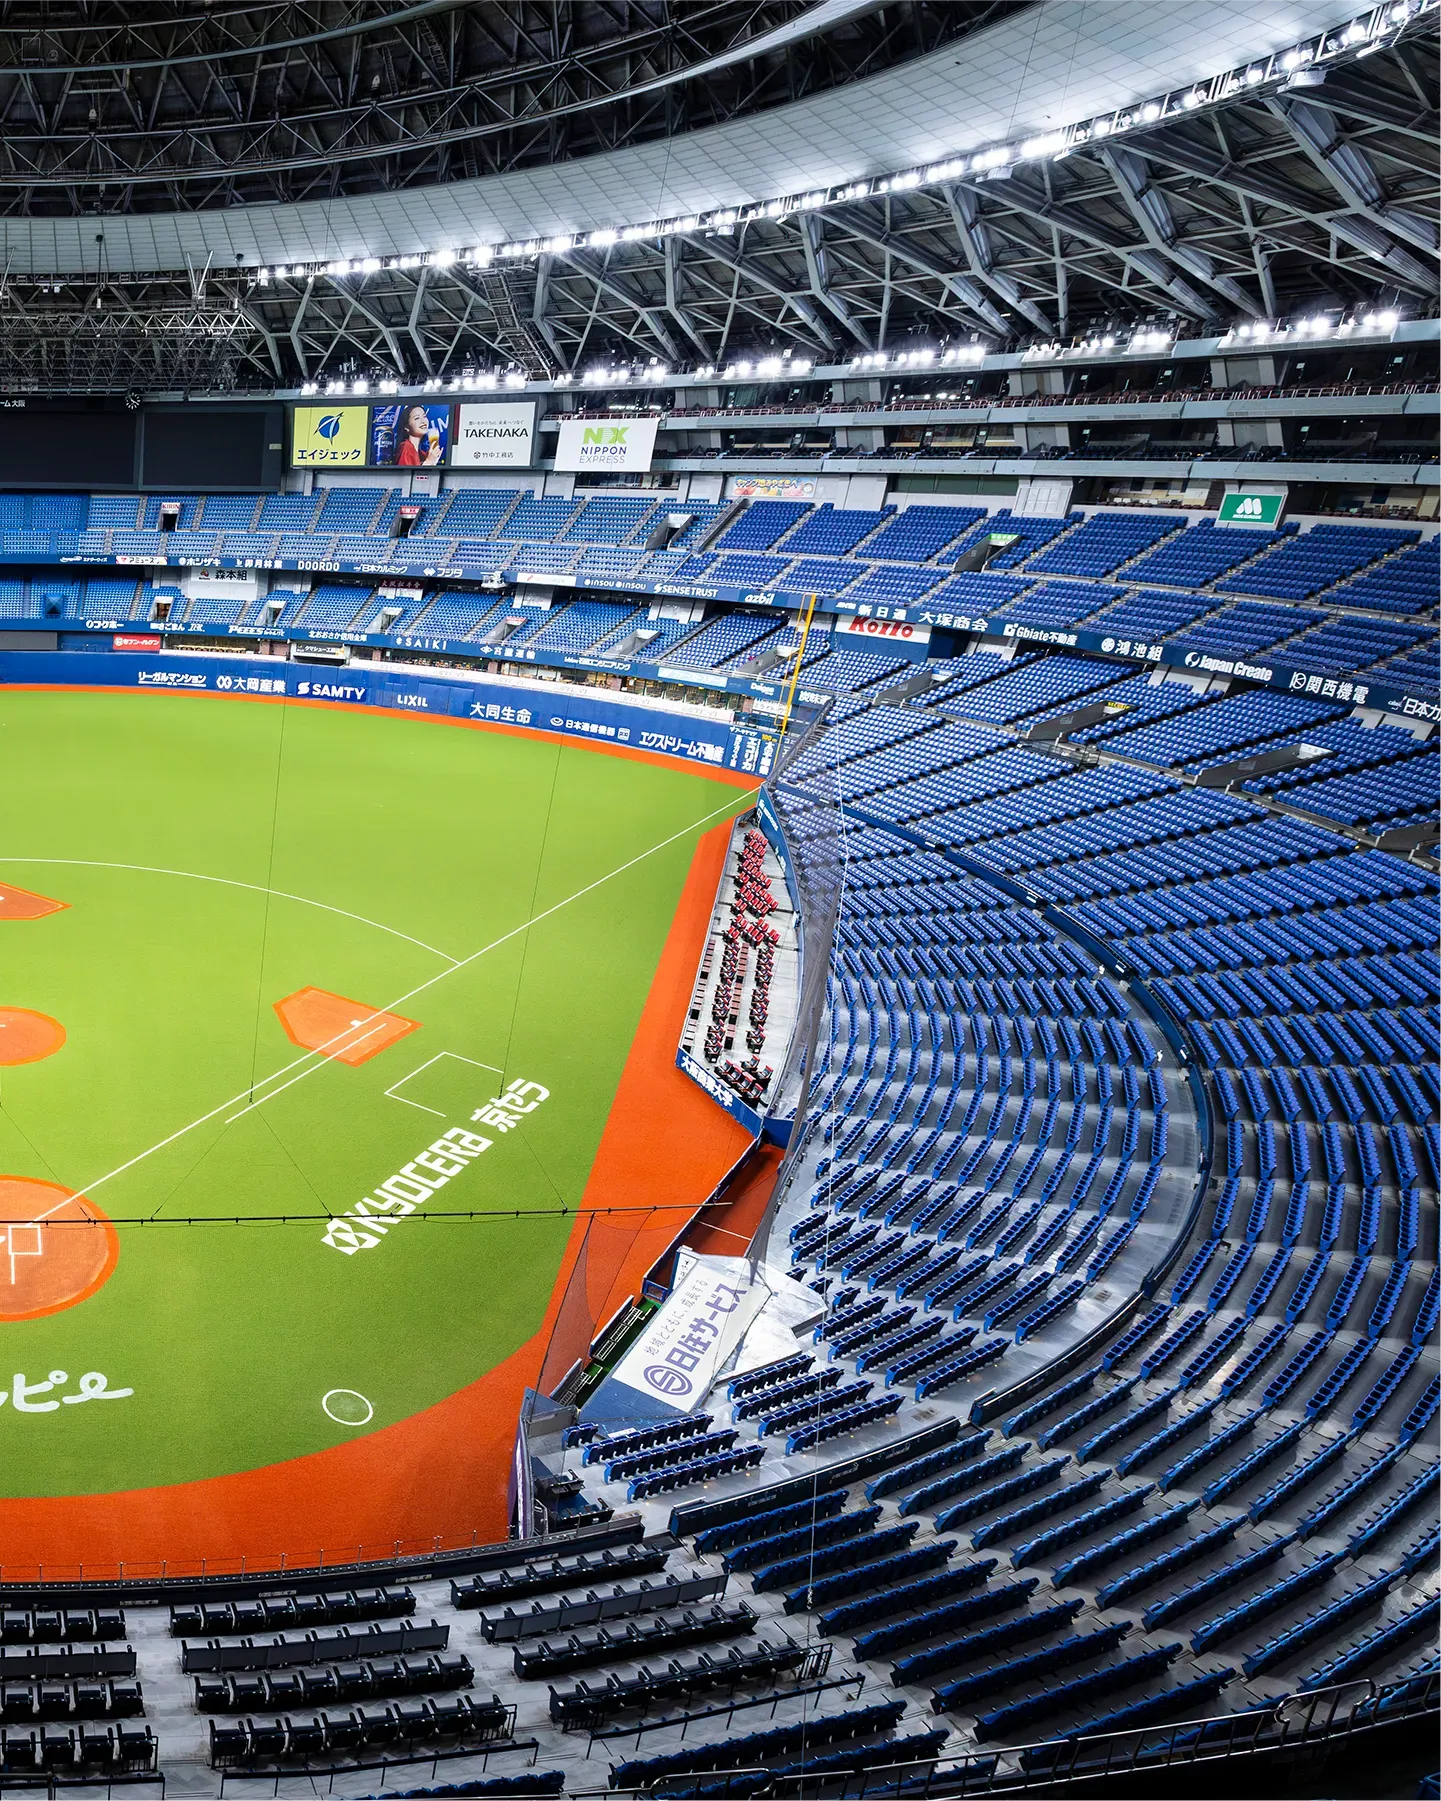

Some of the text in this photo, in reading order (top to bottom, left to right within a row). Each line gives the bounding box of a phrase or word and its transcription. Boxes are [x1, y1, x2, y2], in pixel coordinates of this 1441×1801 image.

[464, 428, 528, 438] TAKENAKA
[298, 449, 361, 460] エイジェック
[580, 446, 627, 454] NIPPON
[579, 456, 625, 464] EXPRESS
[298, 560, 340, 572] DOORDO
[362, 564, 408, 574] 日本カルミック
[215, 570, 248, 580] 森本組
[437, 568, 462, 578] フジタ
[662, 585, 718, 598] SENSE TRUST
[744, 594, 776, 606] azbil
[918, 612, 989, 632] 大塚商会
[308, 630, 368, 642] 北おおさか信用金庫
[406, 637, 446, 650] SAIKI
[1114, 640, 1163, 662] 鴻池組
[1198, 654, 1273, 682] Japan Create
[138, 672, 206, 684] リーガルマンション
[234, 678, 286, 693] 大岡産業
[312, 684, 366, 700] SAMTY
[1306, 676, 1370, 704] 関西機電
[398, 694, 428, 707] LIXIL
[470, 702, 532, 724] 大同生命
[470, 1078, 550, 1132] 京セラ
[344, 1126, 494, 1234] KYOCERA
[644, 1278, 709, 1357] 地域とともに、成長する。
[664, 1283, 748, 1372] 日住サービス
